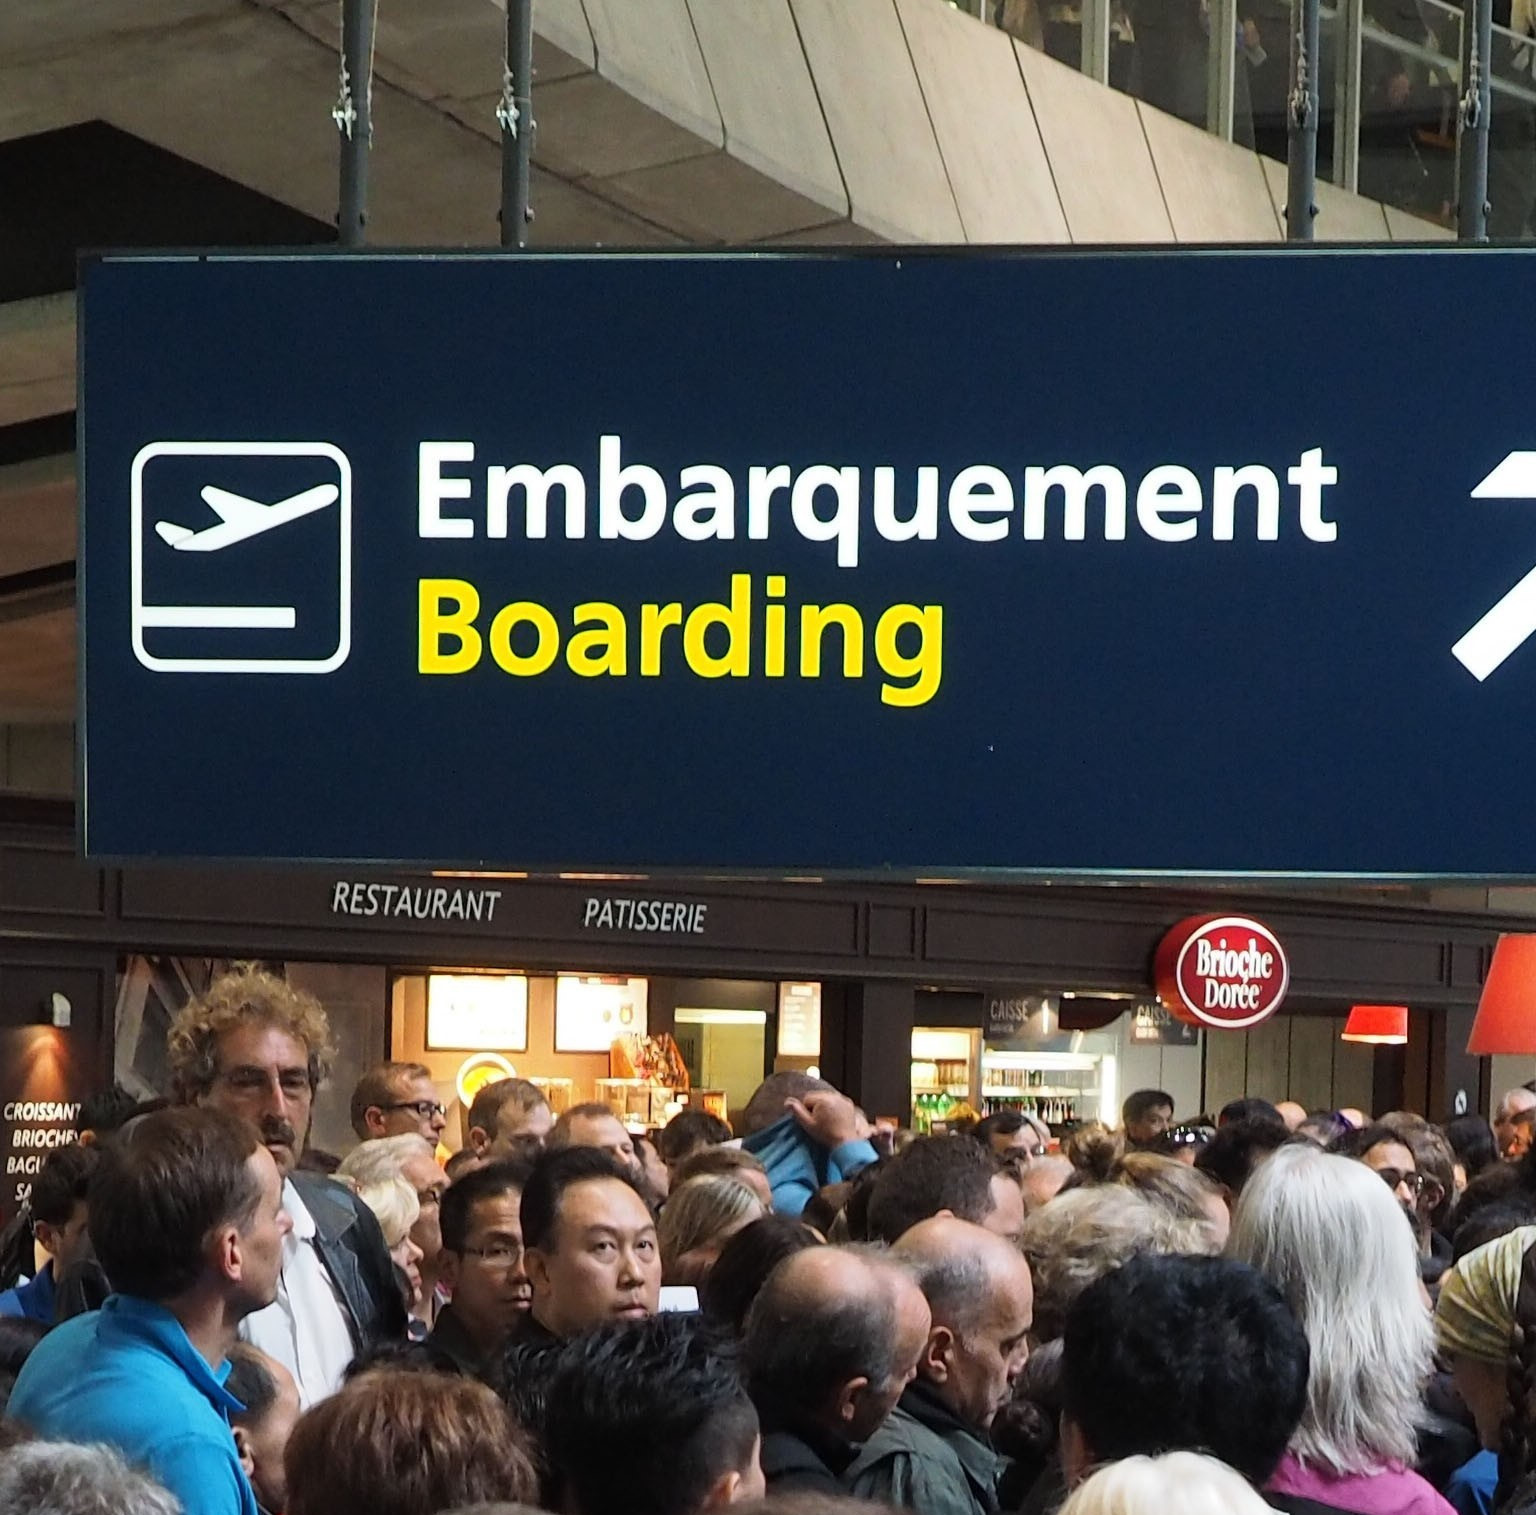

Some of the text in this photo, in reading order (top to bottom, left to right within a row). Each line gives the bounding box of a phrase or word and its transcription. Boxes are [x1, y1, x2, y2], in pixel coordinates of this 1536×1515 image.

[418, 435, 1338, 568] Embarquement
[418, 573, 943, 707] Boarding
[332, 881, 707, 934] RESTAURANT PATISSERIE
[1196, 938, 1274, 980] Brioche
[1205, 977, 1260, 1010] Dorée
[12, 1128, 79, 1148] BRIOCHE
